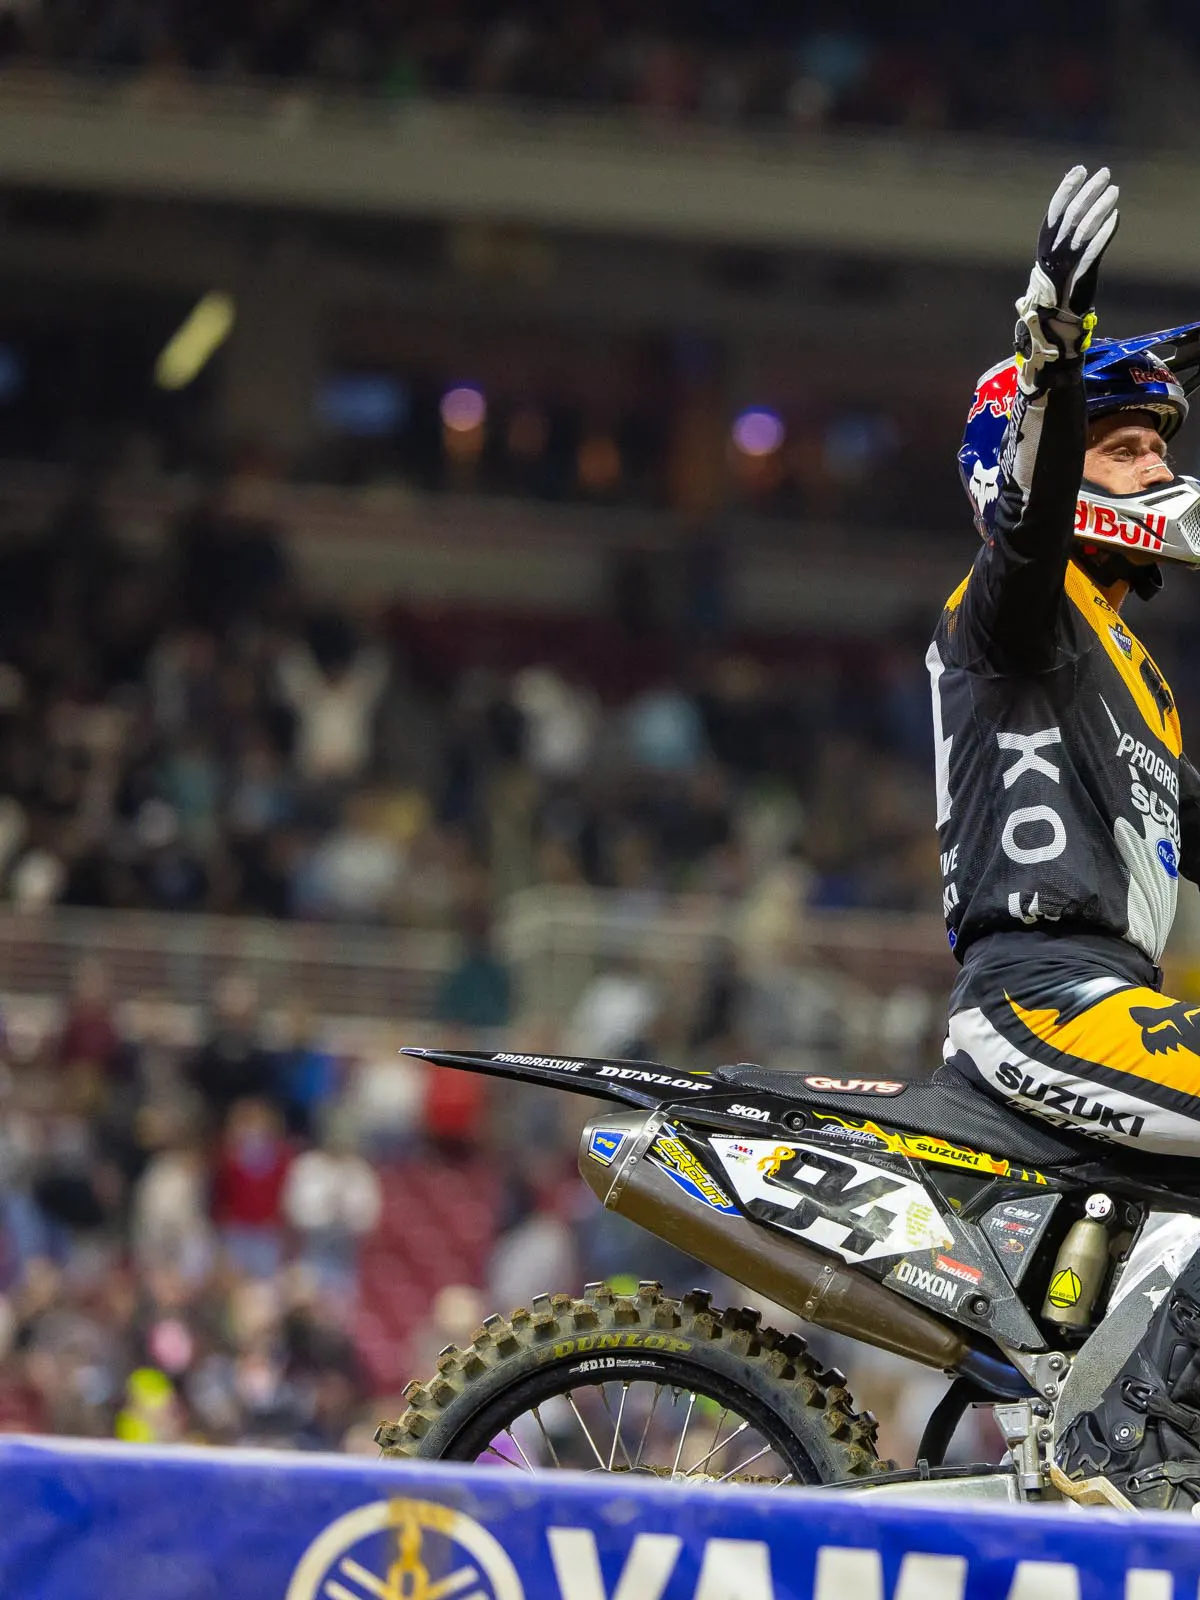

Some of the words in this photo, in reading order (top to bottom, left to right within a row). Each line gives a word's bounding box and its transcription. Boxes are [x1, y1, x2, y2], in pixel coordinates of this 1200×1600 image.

[1094, 506, 1166, 550] Bull
[1116, 733, 1179, 804] PROGRE
[1131, 780, 1181, 849] SUZU
[491, 1053, 585, 1072] PROGRESSIVE
[596, 1066, 713, 1091] DUNLOP
[805, 1077, 903, 1094] GUTS
[996, 1062, 1145, 1138] SUZUKI
[727, 1103, 771, 1122] SKDA
[658, 1138, 730, 1207] CIRCUIT
[916, 1142, 980, 1166] SUZUKI
[745, 1147, 907, 1256] 94
[898, 1262, 958, 1303] DIXXON
[553, 1333, 692, 1359] DUNLOP
